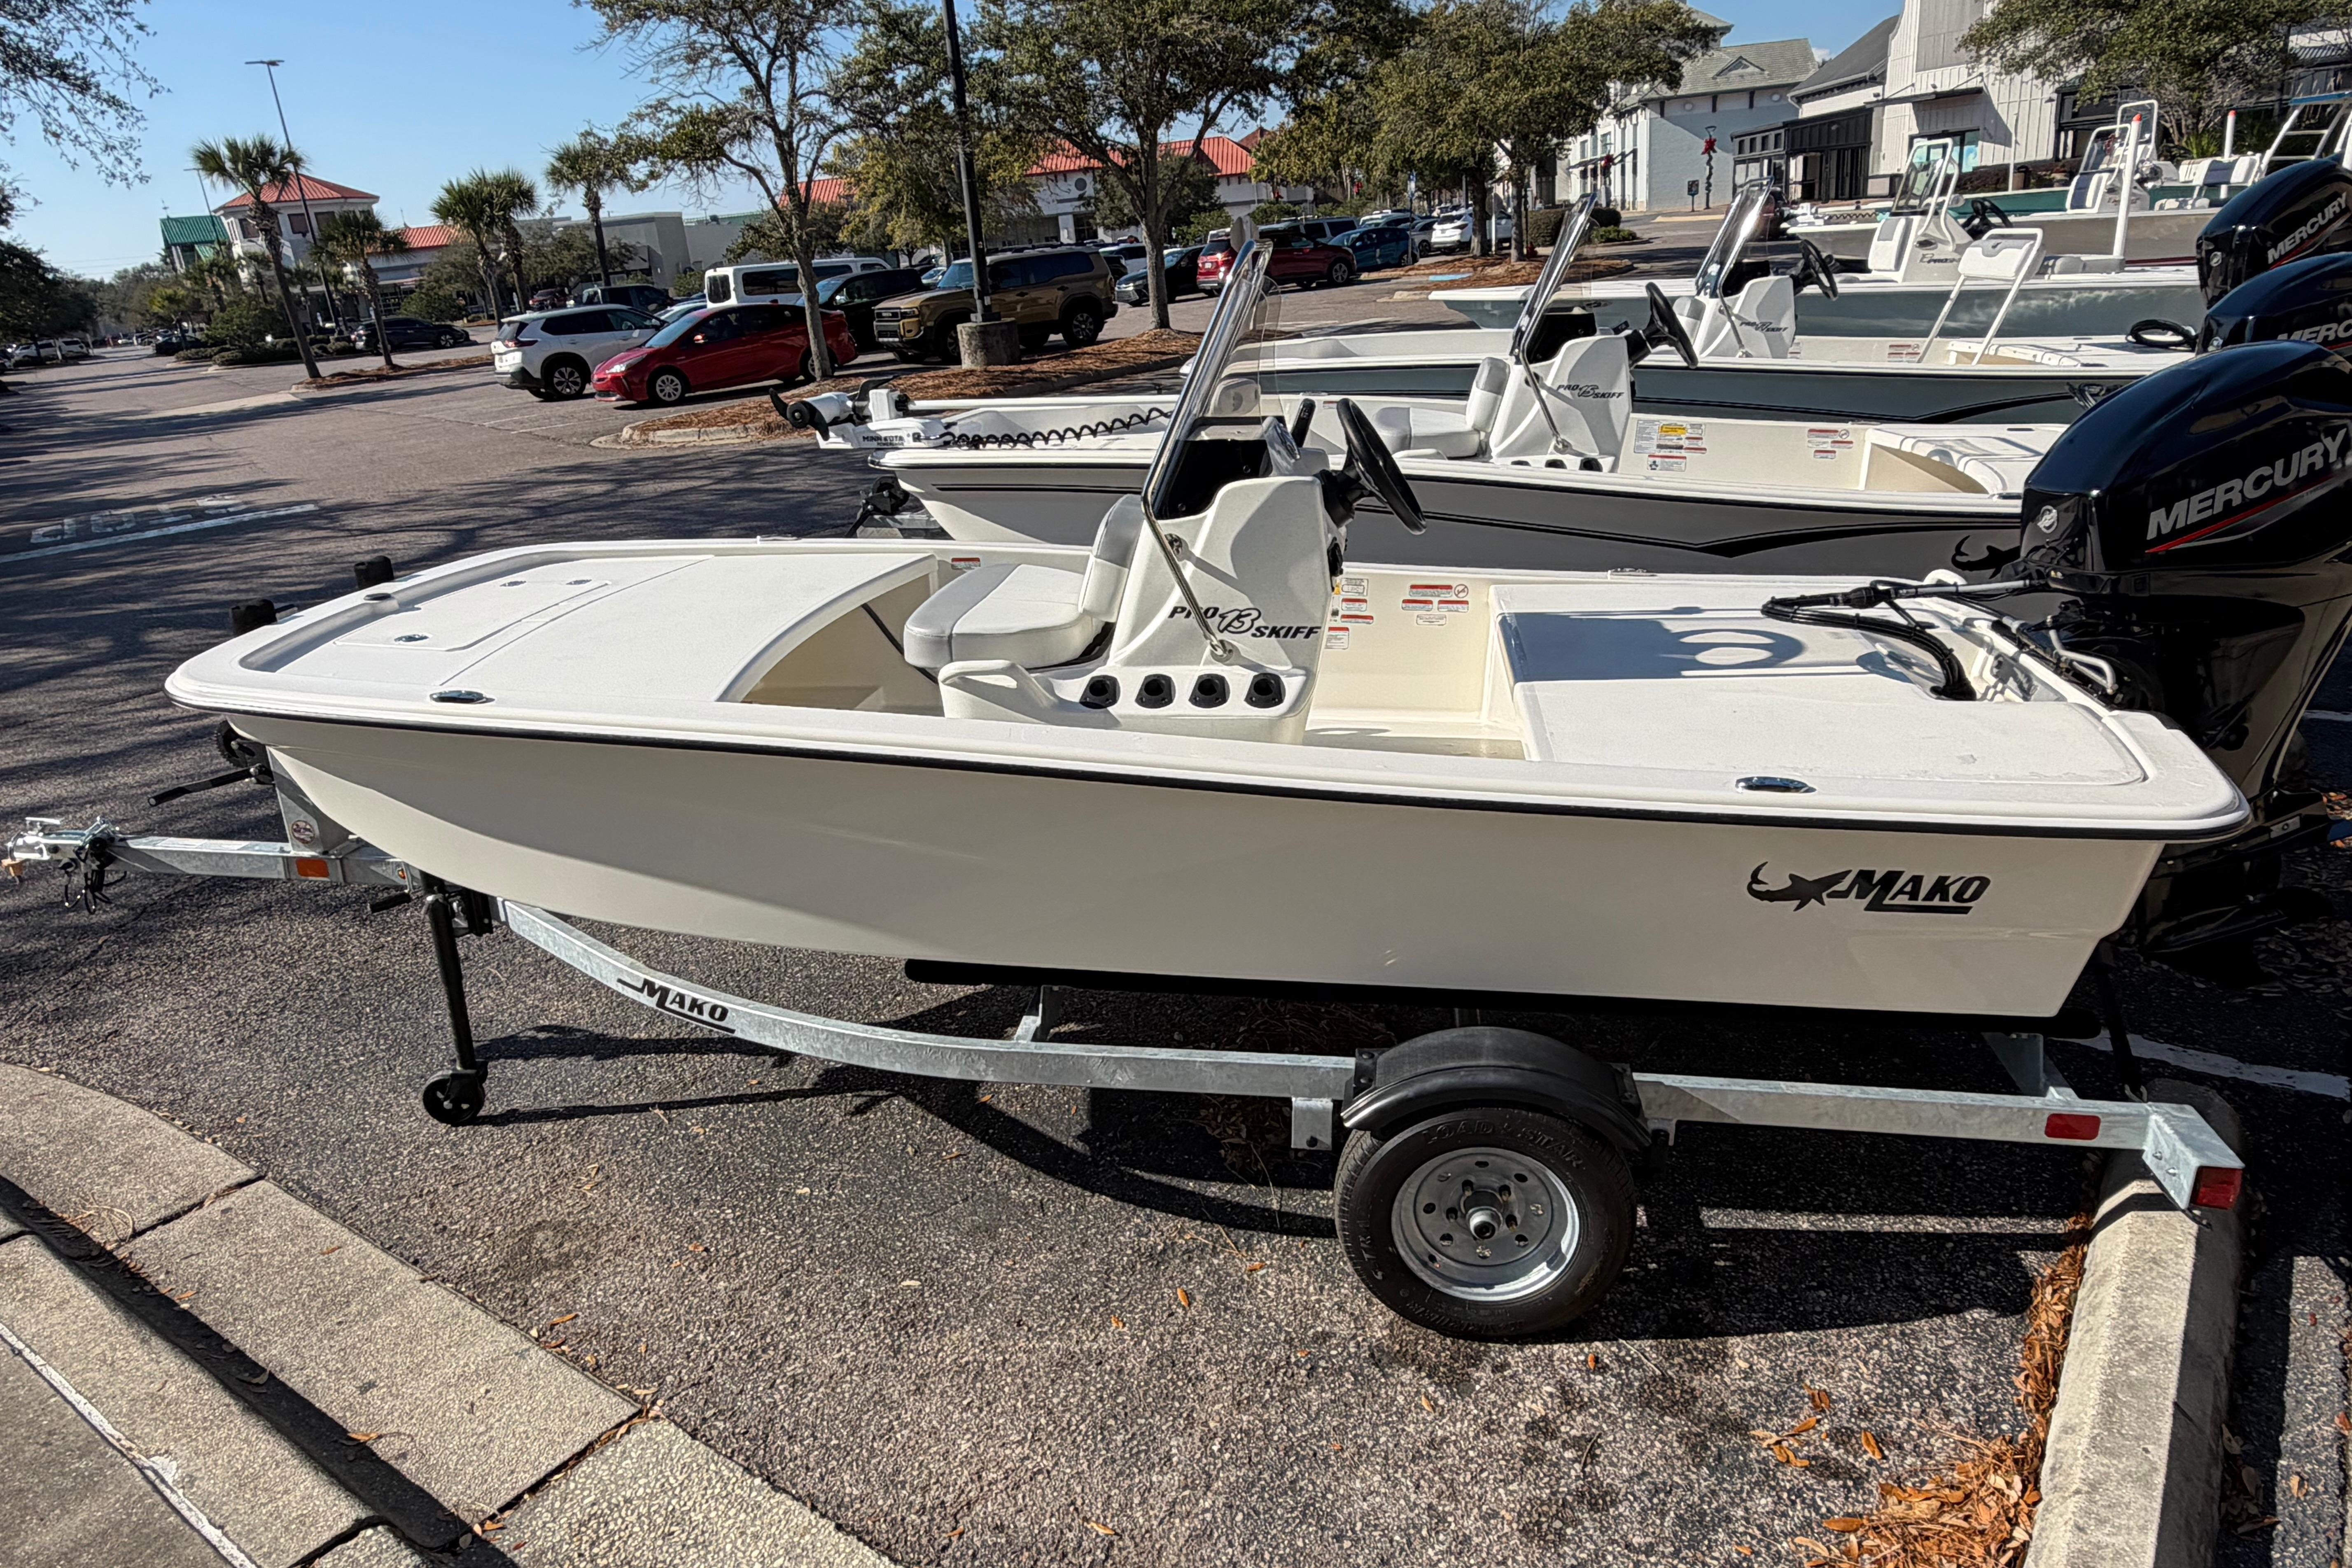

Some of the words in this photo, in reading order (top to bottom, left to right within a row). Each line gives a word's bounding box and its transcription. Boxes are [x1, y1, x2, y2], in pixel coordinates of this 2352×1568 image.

[2267, 191, 2347, 264] MERCURY
[2147, 428, 2347, 540] MERCURY
[1218, 608, 1262, 634] 13
[1251, 626, 1322, 639] SKIFF
[1827, 869, 1991, 915] MAKO
[617, 978, 736, 1034] MAKO
